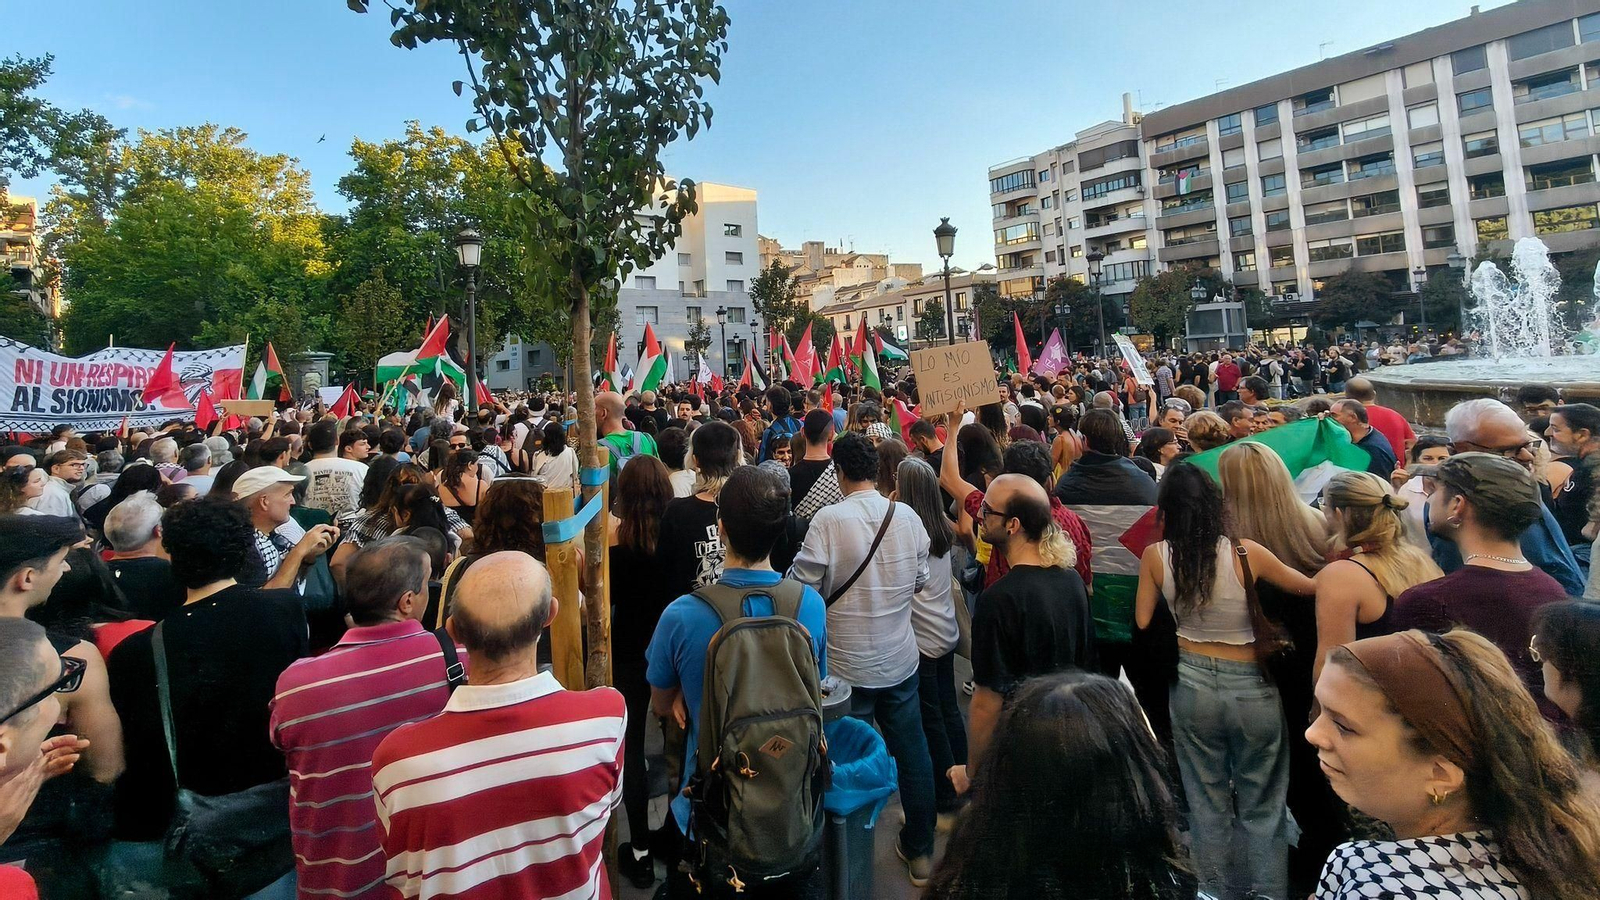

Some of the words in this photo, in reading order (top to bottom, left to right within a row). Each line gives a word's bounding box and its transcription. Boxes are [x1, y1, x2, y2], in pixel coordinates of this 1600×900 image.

[15, 358, 43, 385] NI
[50, 361, 85, 388] UN
[920, 353, 936, 372] LO
[944, 348, 970, 368] MÍO
[943, 372, 960, 383] ES
[10, 386, 46, 413] AL
[925, 378, 995, 411] ANTISIONISMO
